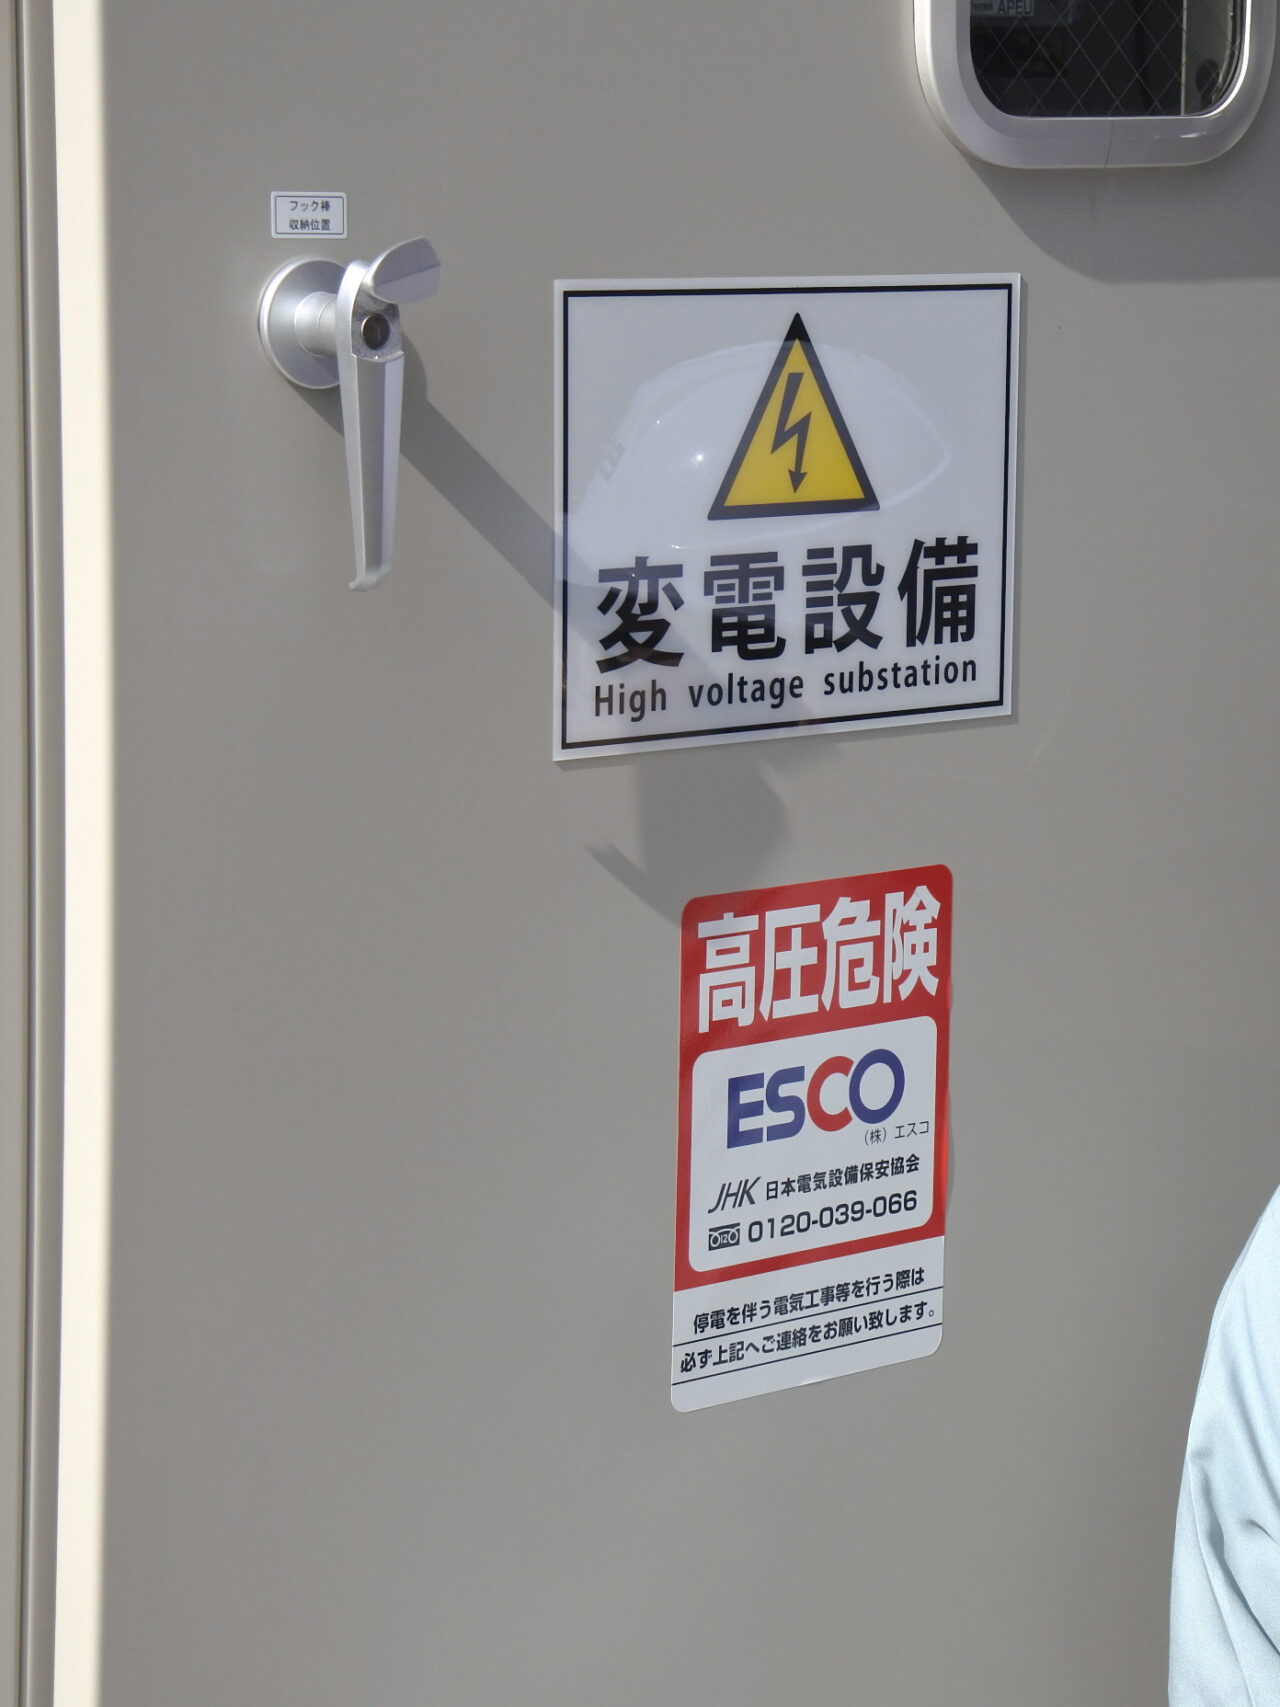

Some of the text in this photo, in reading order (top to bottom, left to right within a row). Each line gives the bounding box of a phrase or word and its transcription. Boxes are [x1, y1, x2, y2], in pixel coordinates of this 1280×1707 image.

[288, 218, 331, 232] 収納位置
[289, 200, 331, 213] フック棒
[595, 536, 979, 674] 変電設備
[594, 655, 977, 722] High voltage substation
[697, 885, 942, 1034] 高圧危険
[727, 1048, 906, 1149] ESCO
[707, 1153, 920, 1214] JHK 日本電気設備保安協会
[748, 1189, 918, 1243] 0120-039-066
[693, 1266, 925, 1335] 停電を伴う電気工事等を行う際は
[679, 1301, 935, 1374] 必ず上記へご連絡をお願い致します。
